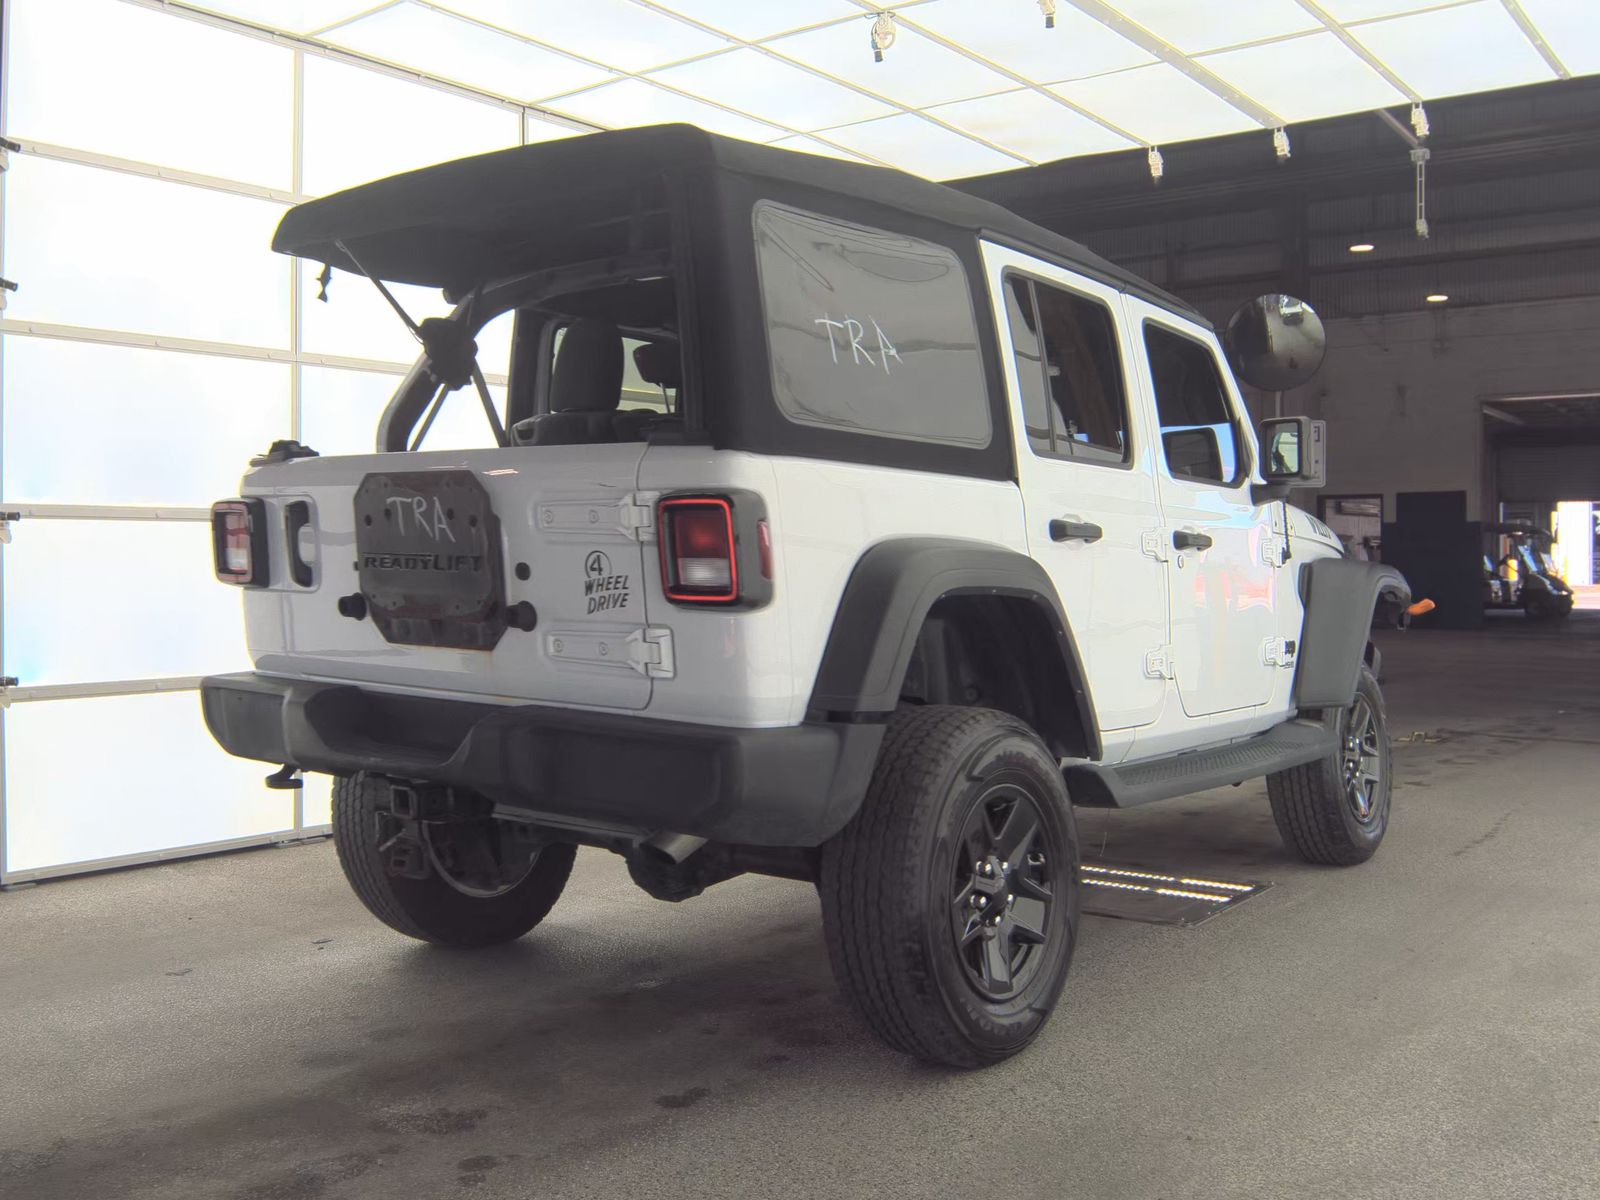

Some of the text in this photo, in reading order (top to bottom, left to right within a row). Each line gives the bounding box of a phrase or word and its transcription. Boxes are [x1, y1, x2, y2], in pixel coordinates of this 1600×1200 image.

[815, 312, 903, 375] TRA
[386, 496, 456, 542] TRA
[363, 554, 482, 572] READYLIFT
[588, 553, 604, 577] 4
[584, 575, 629, 597] WHEEL
[587, 592, 629, 615] DRIVE
